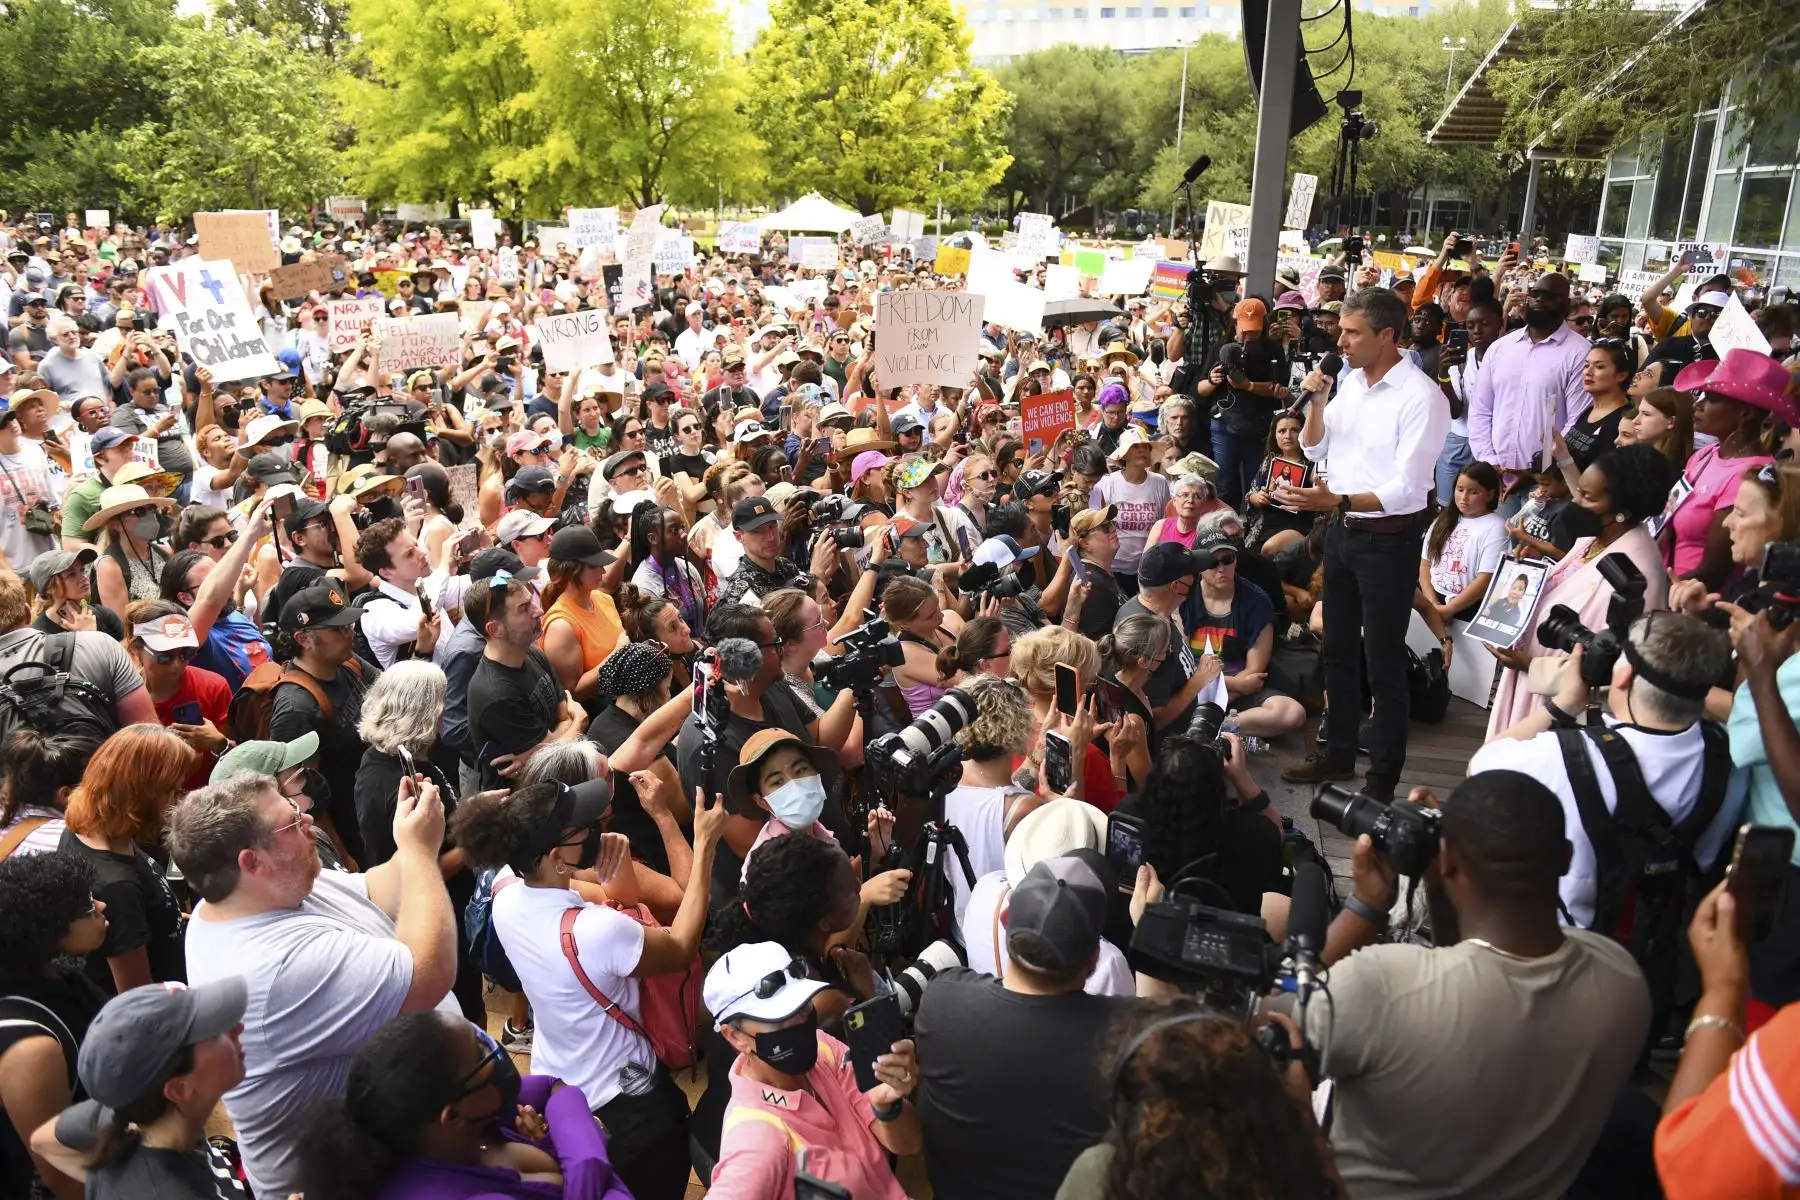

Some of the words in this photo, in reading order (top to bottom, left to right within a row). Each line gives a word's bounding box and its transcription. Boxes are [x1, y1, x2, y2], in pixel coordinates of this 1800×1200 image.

[1631, 272, 1646, 281] AM
[1648, 272, 1661, 282] NO
[334, 303, 362, 315] NRA
[368, 302, 380, 312] IS
[878, 291, 973, 327] FREEDOM
[176, 311, 205, 336] For
[206, 308, 236, 331] Our
[537, 312, 600, 345] WRONG
[402, 335, 437, 347] FURY
[907, 327, 939, 344] FROM
[189, 333, 270, 367] Children
[400, 346, 444, 358] ANGRY
[910, 343, 929, 352] GUN
[380, 353, 460, 373] PEDIATRICIAN
[1027, 407, 1038, 420] WE
[1039, 403, 1054, 417] CAN
[1055, 400, 1069, 413] END
[1024, 418, 1039, 432] GUN
[1040, 410, 1073, 428] VIOLENCE
[1118, 502, 1156, 512] ABORT
[1120, 511, 1154, 522] GREG
